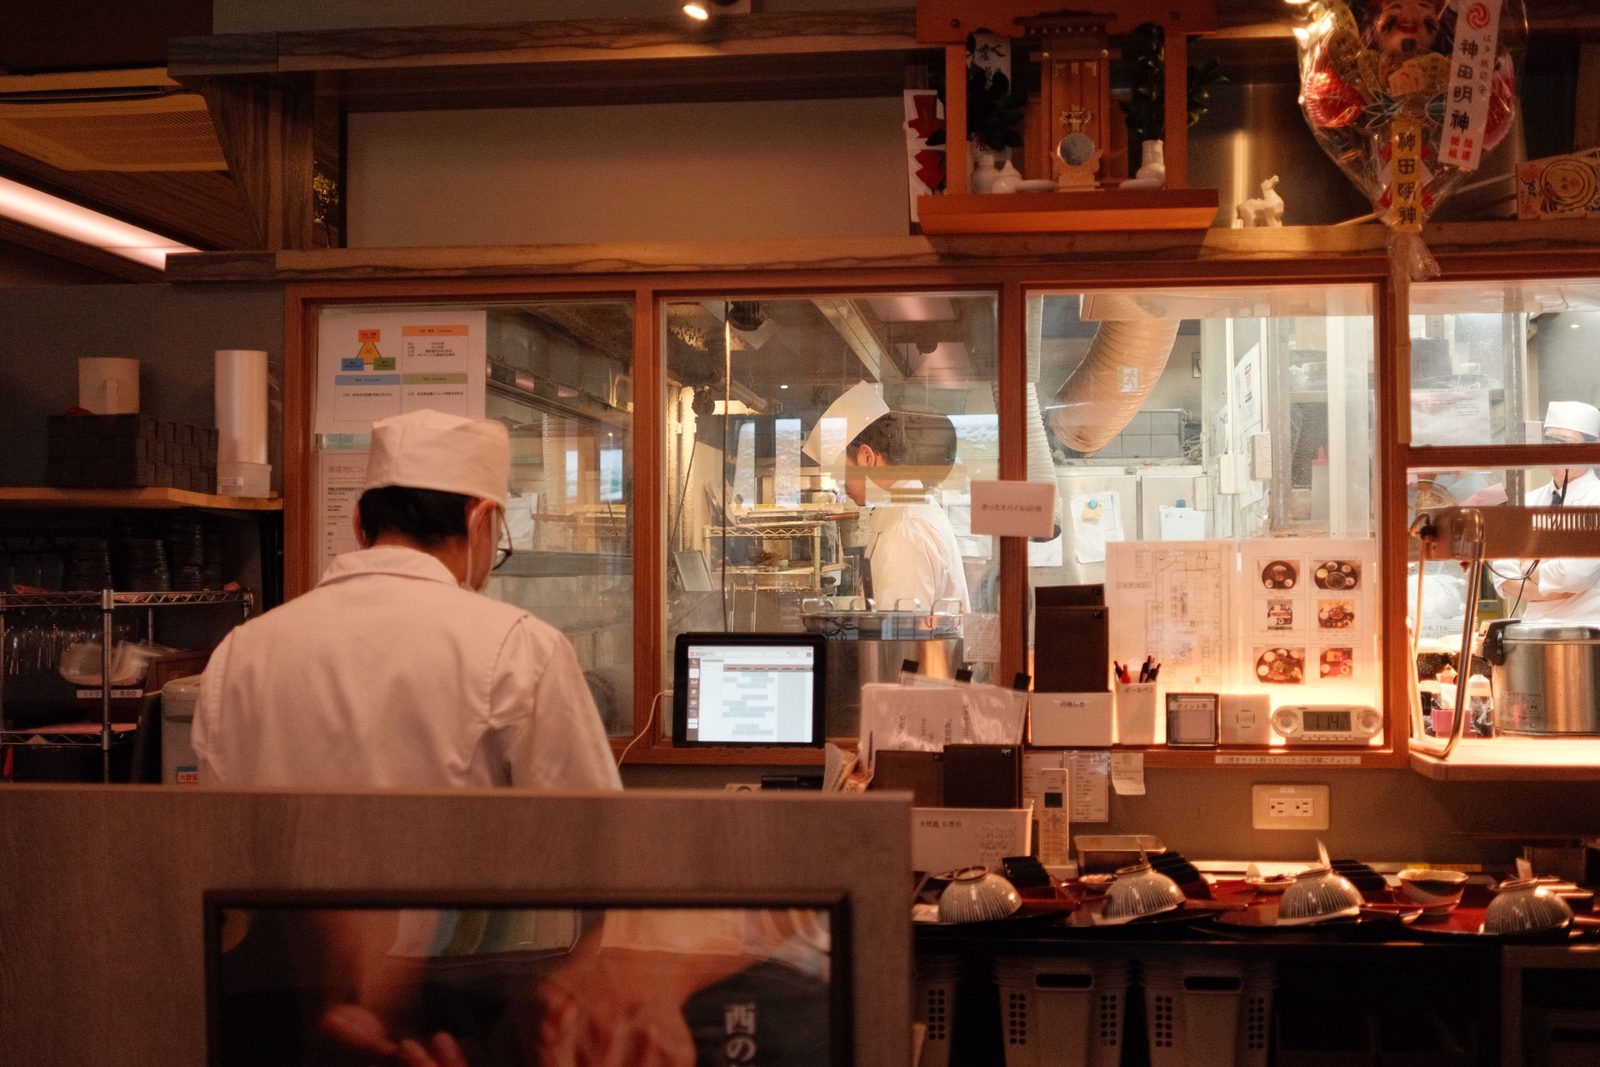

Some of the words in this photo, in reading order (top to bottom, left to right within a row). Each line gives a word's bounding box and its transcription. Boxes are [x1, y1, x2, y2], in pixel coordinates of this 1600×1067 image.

[1450, 39, 1478, 133] 神田明神
[1397, 133, 1417, 225] 神田明神
[725, 1003, 757, 1067] 西の
